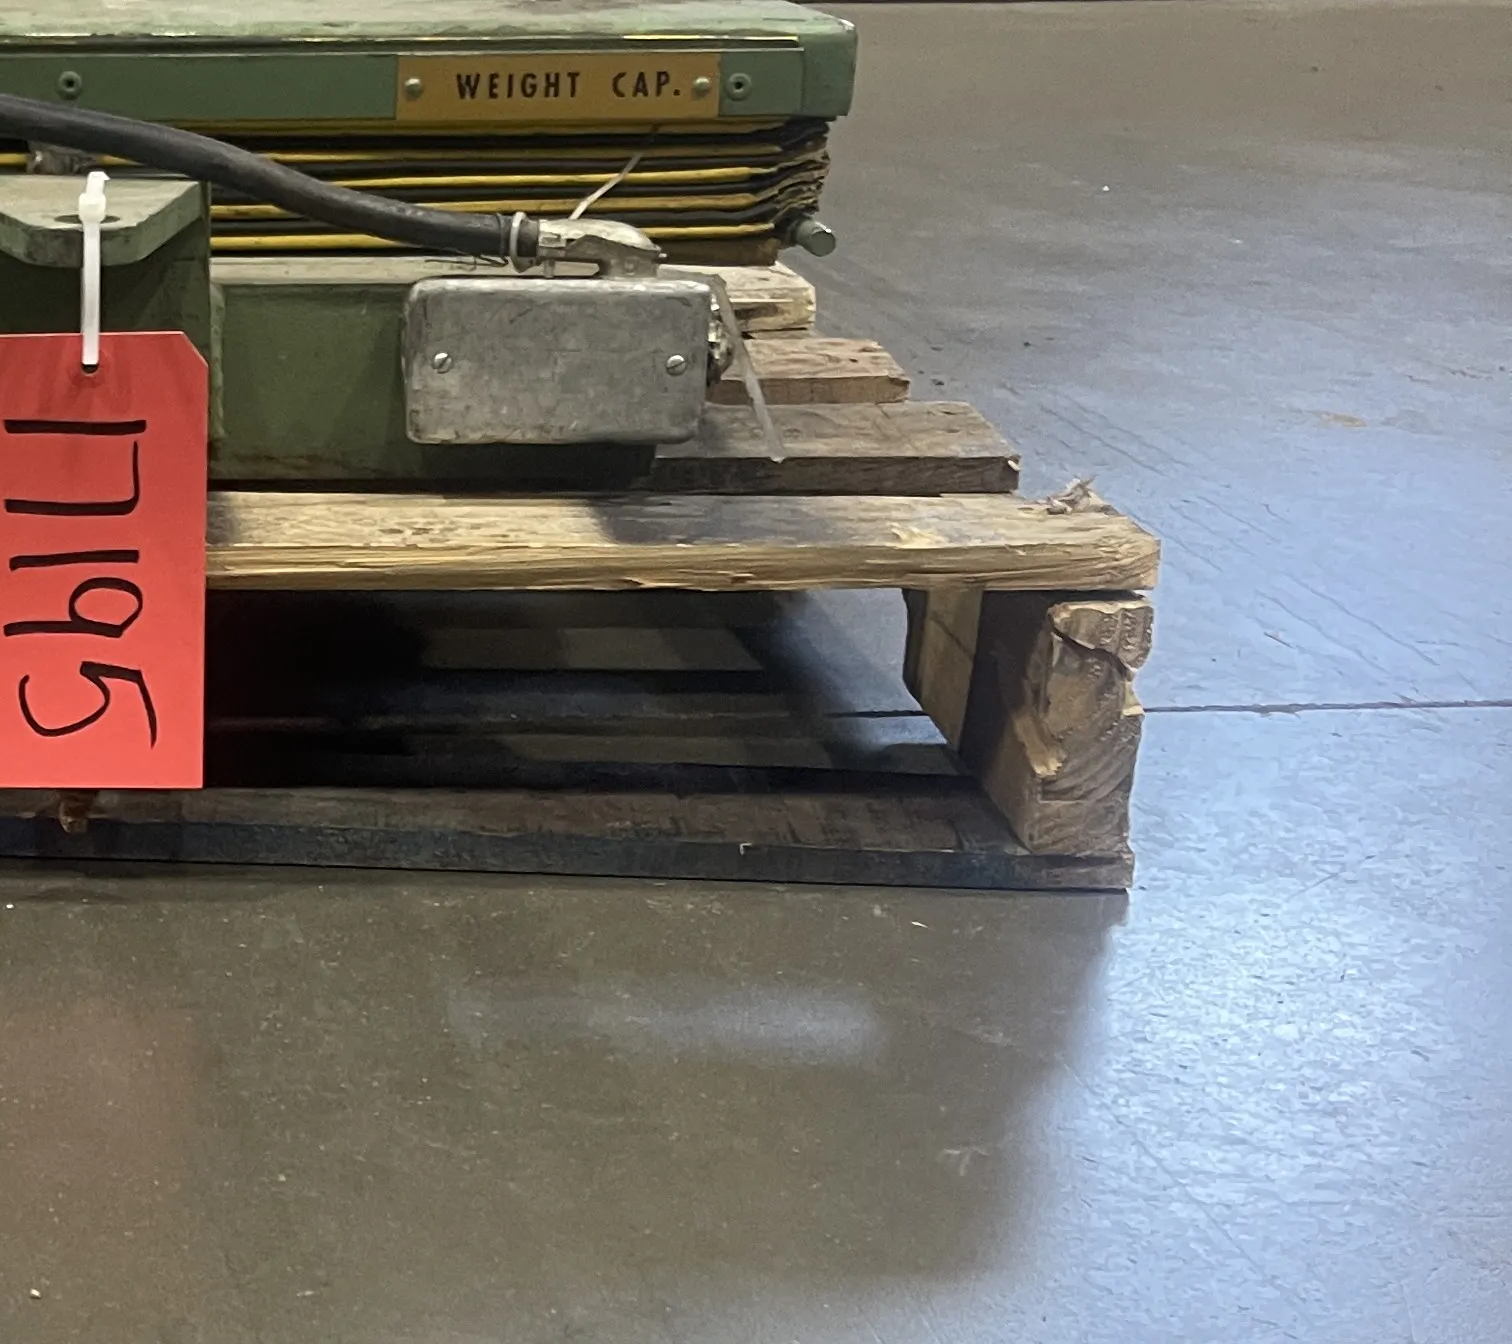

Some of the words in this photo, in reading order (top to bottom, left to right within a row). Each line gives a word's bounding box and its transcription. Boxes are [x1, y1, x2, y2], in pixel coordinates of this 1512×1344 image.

[455, 71, 581, 100] WEIGHT
[611, 70, 681, 99] CAP.
[3, 419, 158, 749] 17195
